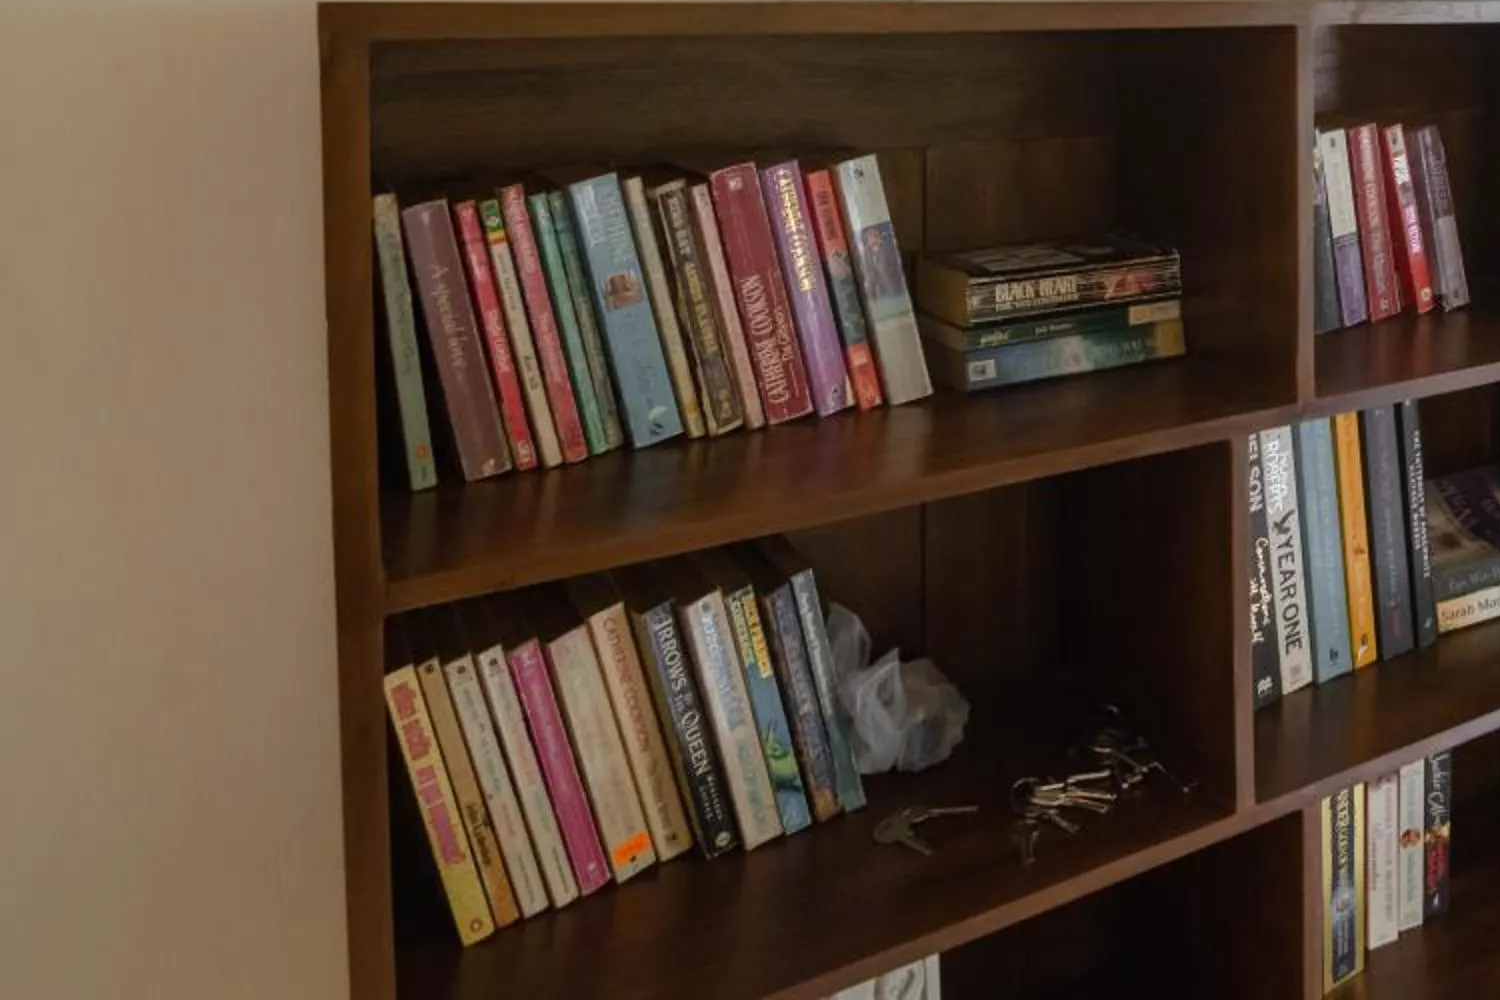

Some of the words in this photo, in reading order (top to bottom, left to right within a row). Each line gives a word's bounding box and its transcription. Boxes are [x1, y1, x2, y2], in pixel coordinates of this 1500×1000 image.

[428, 261, 450, 279] A
[994, 280, 1035, 300] BLACK
[430, 280, 461, 336] special
[739, 275, 768, 334] COOKSON
[754, 337, 790, 404] CATHERINE
[1275, 533, 1296, 601] YEAR
[1281, 603, 1302, 654] ONE
[1440, 604, 1476, 624] Sarah
[652, 614, 687, 691] ARROWS
[680, 710, 712, 777] QUEEN
